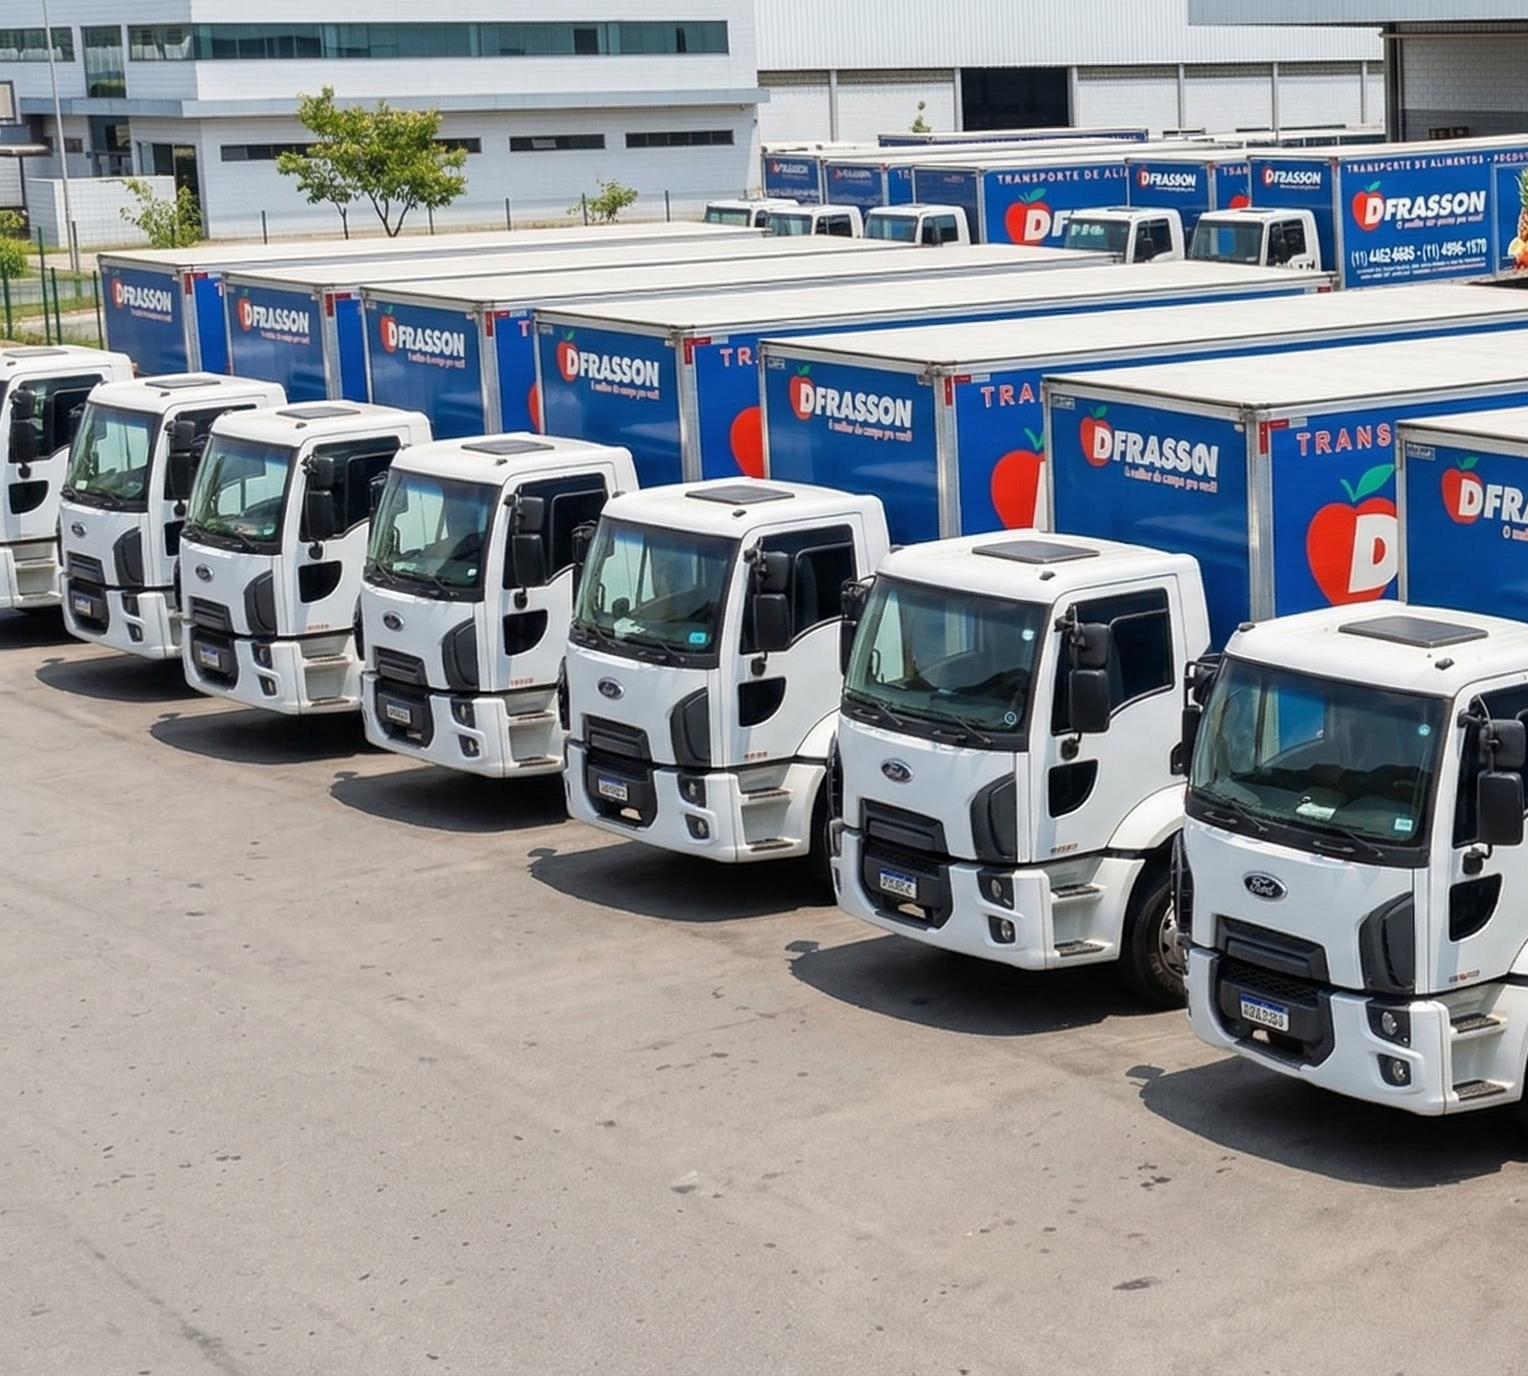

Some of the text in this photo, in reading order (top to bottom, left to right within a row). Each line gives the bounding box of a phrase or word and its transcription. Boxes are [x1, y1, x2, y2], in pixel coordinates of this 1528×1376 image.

[1364, 190, 1487, 225] DFRASSON
[116, 284, 172, 312] DFRASSON
[243, 304, 310, 333] DFRASSON
[387, 322, 465, 357] DFRASSON
[566, 350, 660, 388] DFRASSON
[799, 380, 913, 428] DFRASSON
[1296, 421, 1393, 457] TRANS
